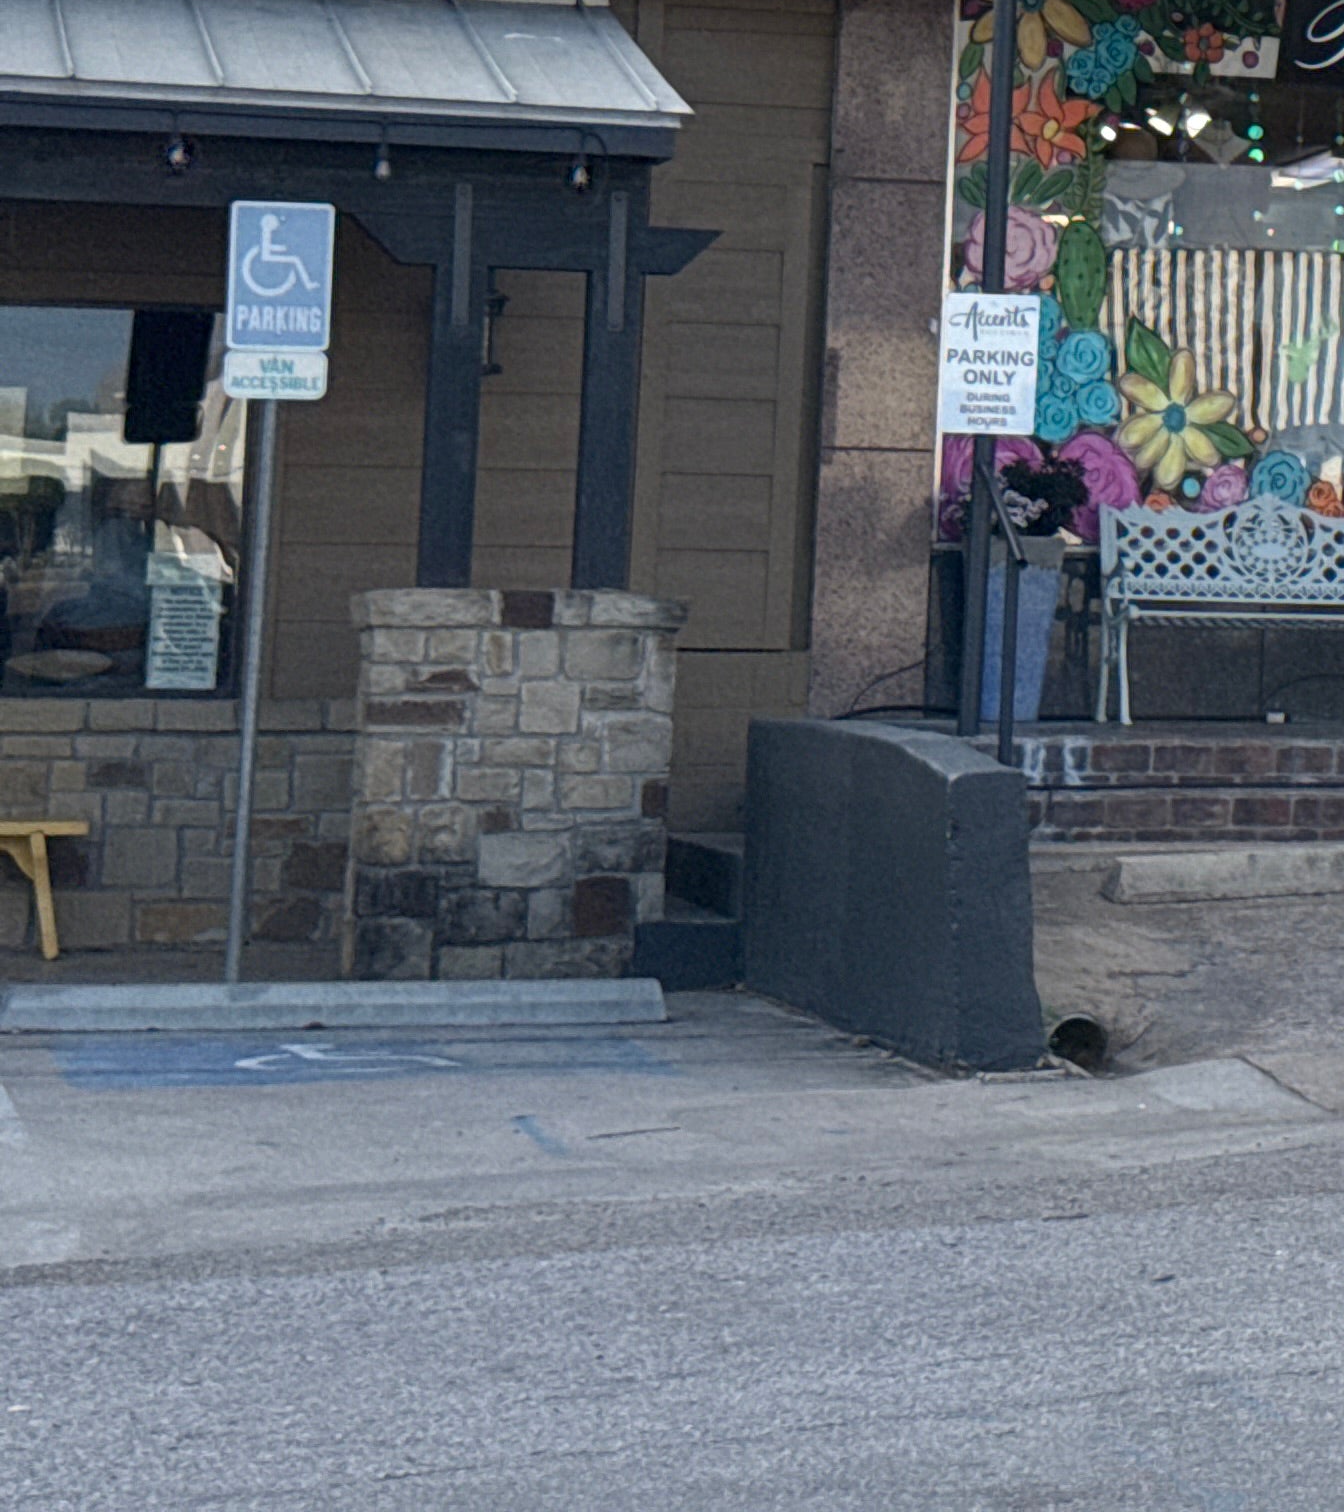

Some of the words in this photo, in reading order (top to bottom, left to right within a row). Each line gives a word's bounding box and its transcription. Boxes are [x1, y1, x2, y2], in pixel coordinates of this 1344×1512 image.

[236, 305, 322, 333] PARKING
[949, 301, 1036, 342] Accents
[946, 349, 1034, 366] PARKING
[260, 358, 294, 374] VAN
[231, 376, 320, 391] ACCESSIBLE
[963, 369, 1016, 386] ONLY
[966, 392, 1010, 403] DURING
[960, 404, 1016, 415] BUSINESS
[967, 417, 1007, 427] HOURS
